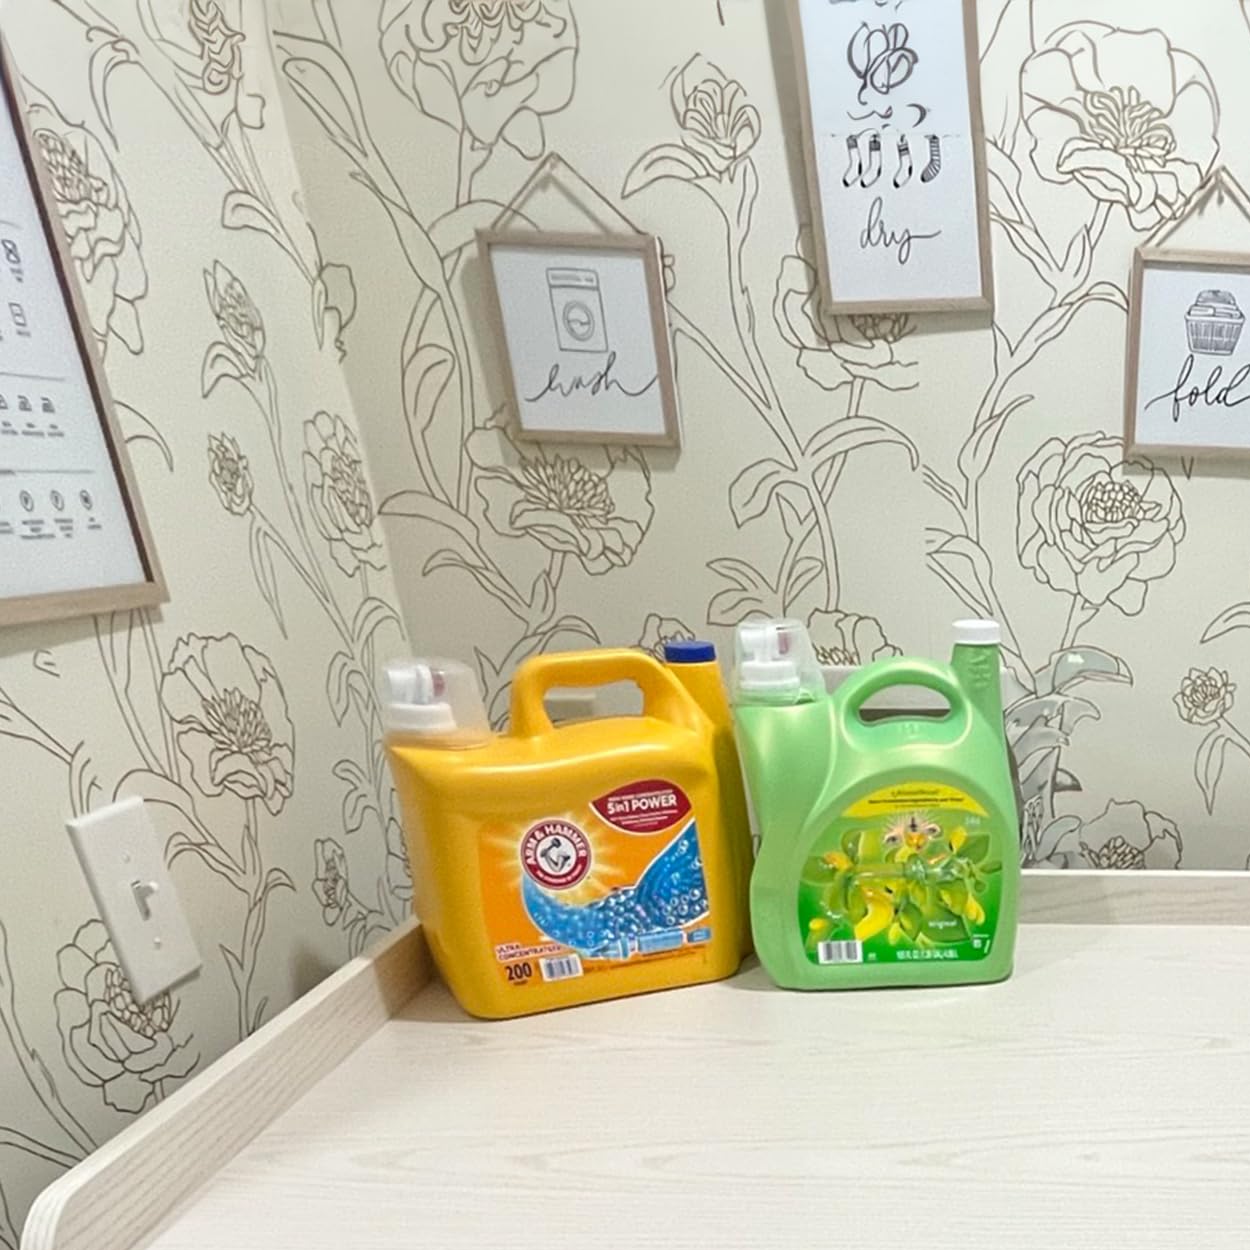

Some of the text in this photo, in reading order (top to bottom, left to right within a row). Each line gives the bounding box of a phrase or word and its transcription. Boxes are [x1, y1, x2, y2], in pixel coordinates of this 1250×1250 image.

[860, 195, 942, 265] dry
[524, 351, 659, 402] wash
[631, 793, 678, 811] POWER
[525, 837, 538, 865] ARM
[544, 823, 588, 857] HAMMER
[505, 962, 533, 981] 200
